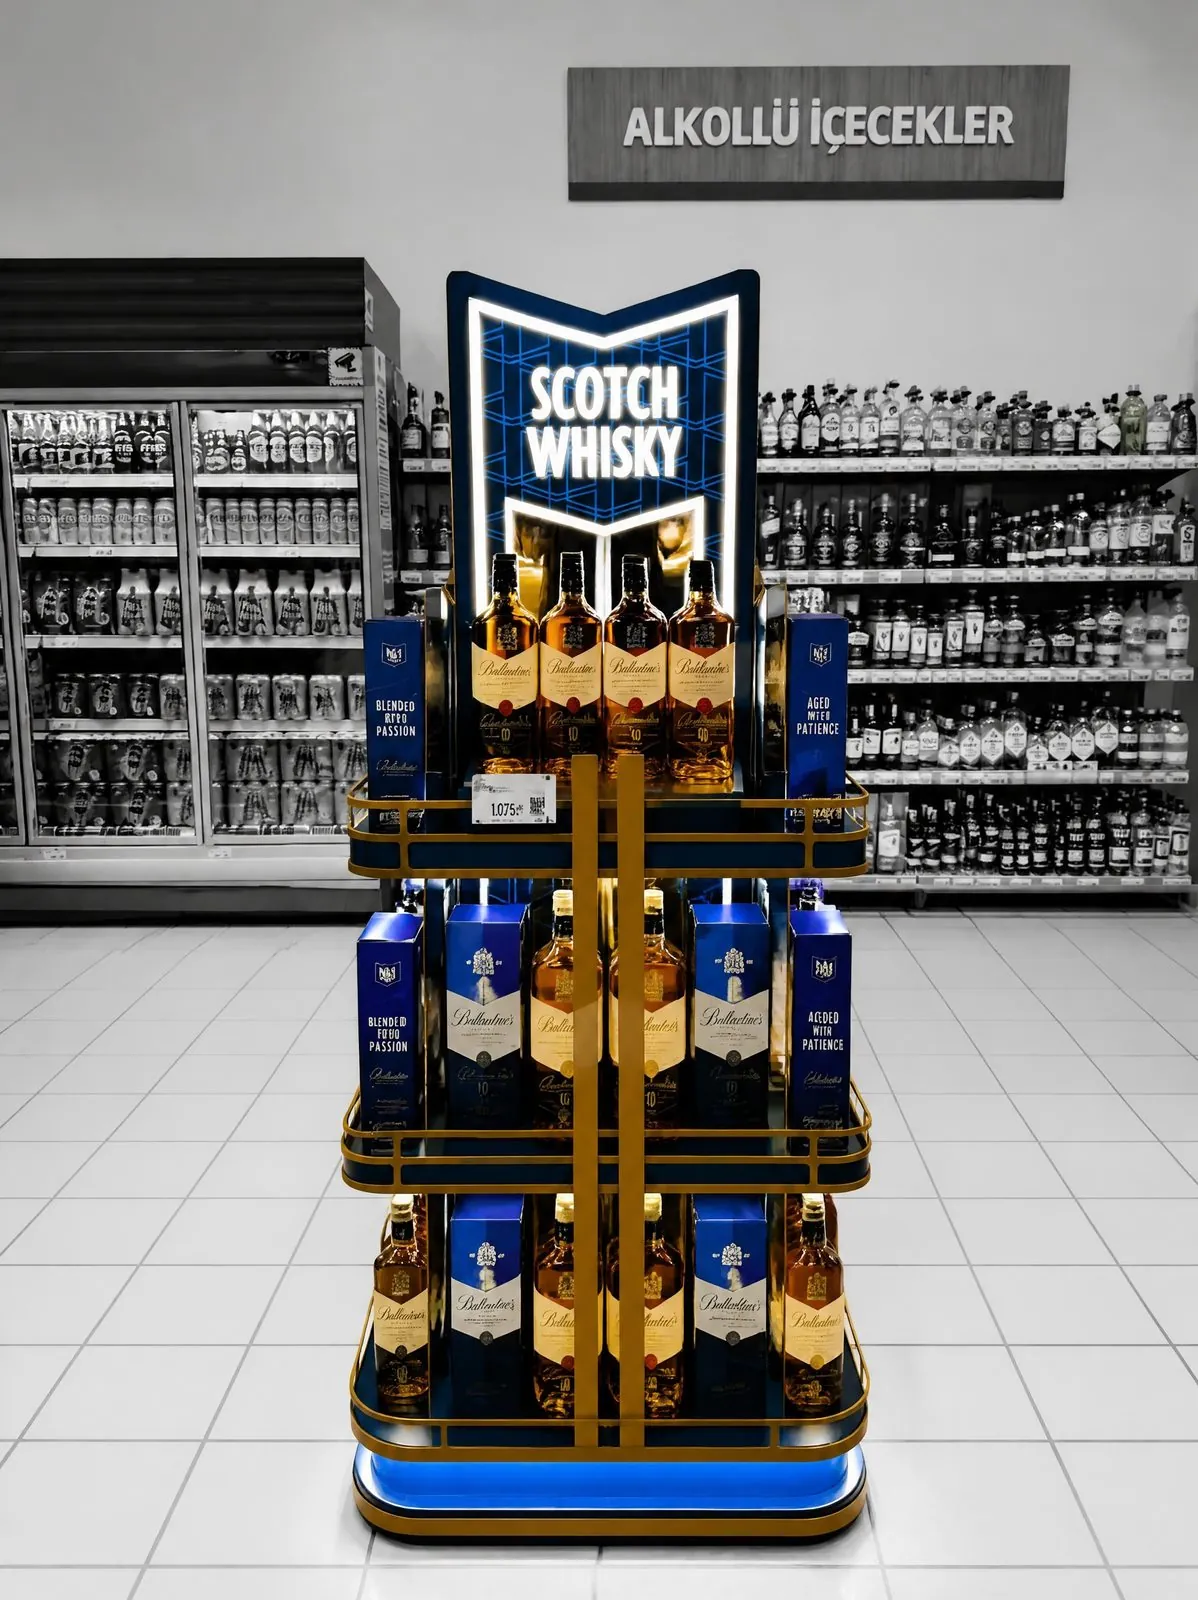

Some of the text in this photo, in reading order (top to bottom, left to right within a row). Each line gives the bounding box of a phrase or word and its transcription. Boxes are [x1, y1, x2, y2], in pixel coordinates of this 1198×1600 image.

[623, 96, 1015, 155] ALKOLLÜ İÇECEKLER
[530, 365, 679, 421] SCOTCH
[525, 425, 684, 479] WHISKY
[376, 699, 415, 712] BLENDED
[807, 697, 830, 709] AGED
[376, 725, 416, 737] PASSION
[796, 723, 839, 735] PATIENCE
[369, 1041, 408, 1052] PASSION
[802, 1038, 844, 1051] PATIENCE
